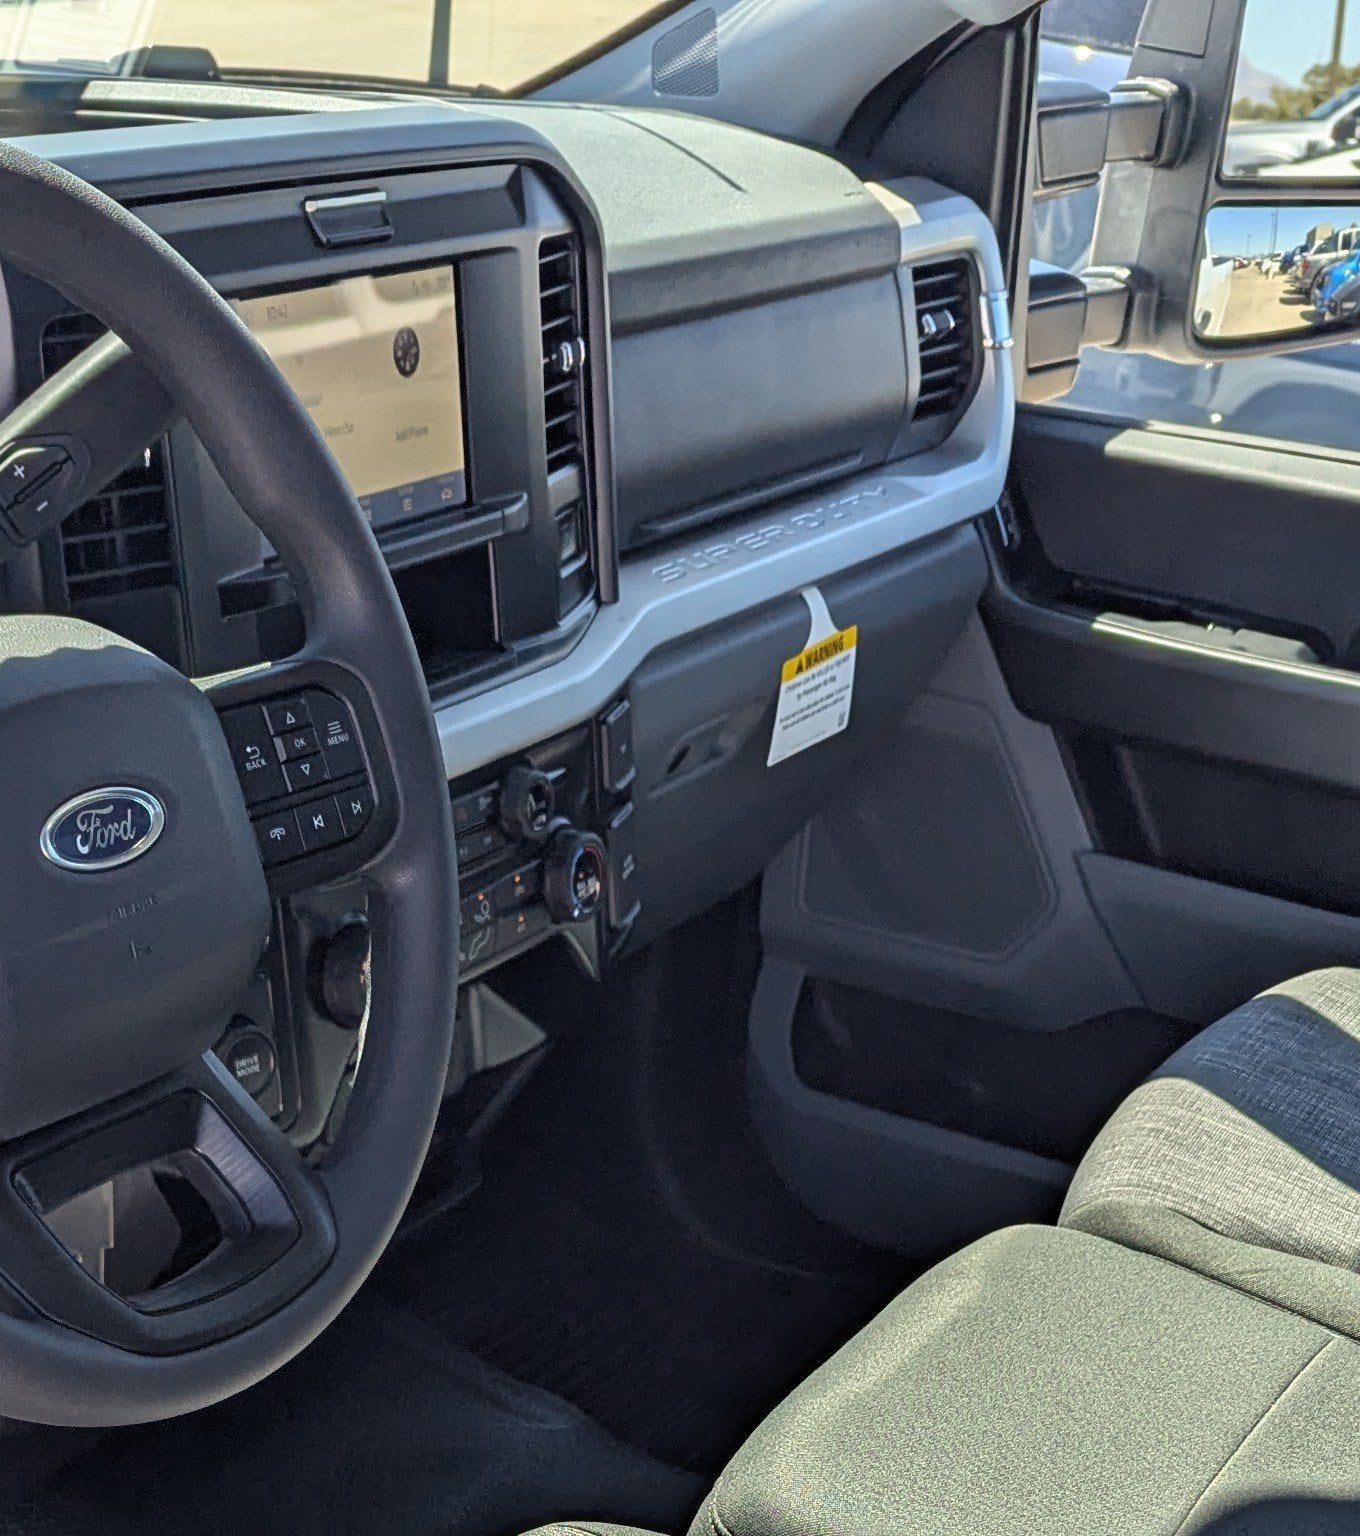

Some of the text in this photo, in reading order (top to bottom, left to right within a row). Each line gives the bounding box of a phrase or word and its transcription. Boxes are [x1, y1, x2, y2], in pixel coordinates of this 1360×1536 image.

[294, 737, 307, 748] OK
[327, 733, 350, 746] MENU
[246, 758, 267, 771] BACK
[76, 805, 136, 855] Ford
